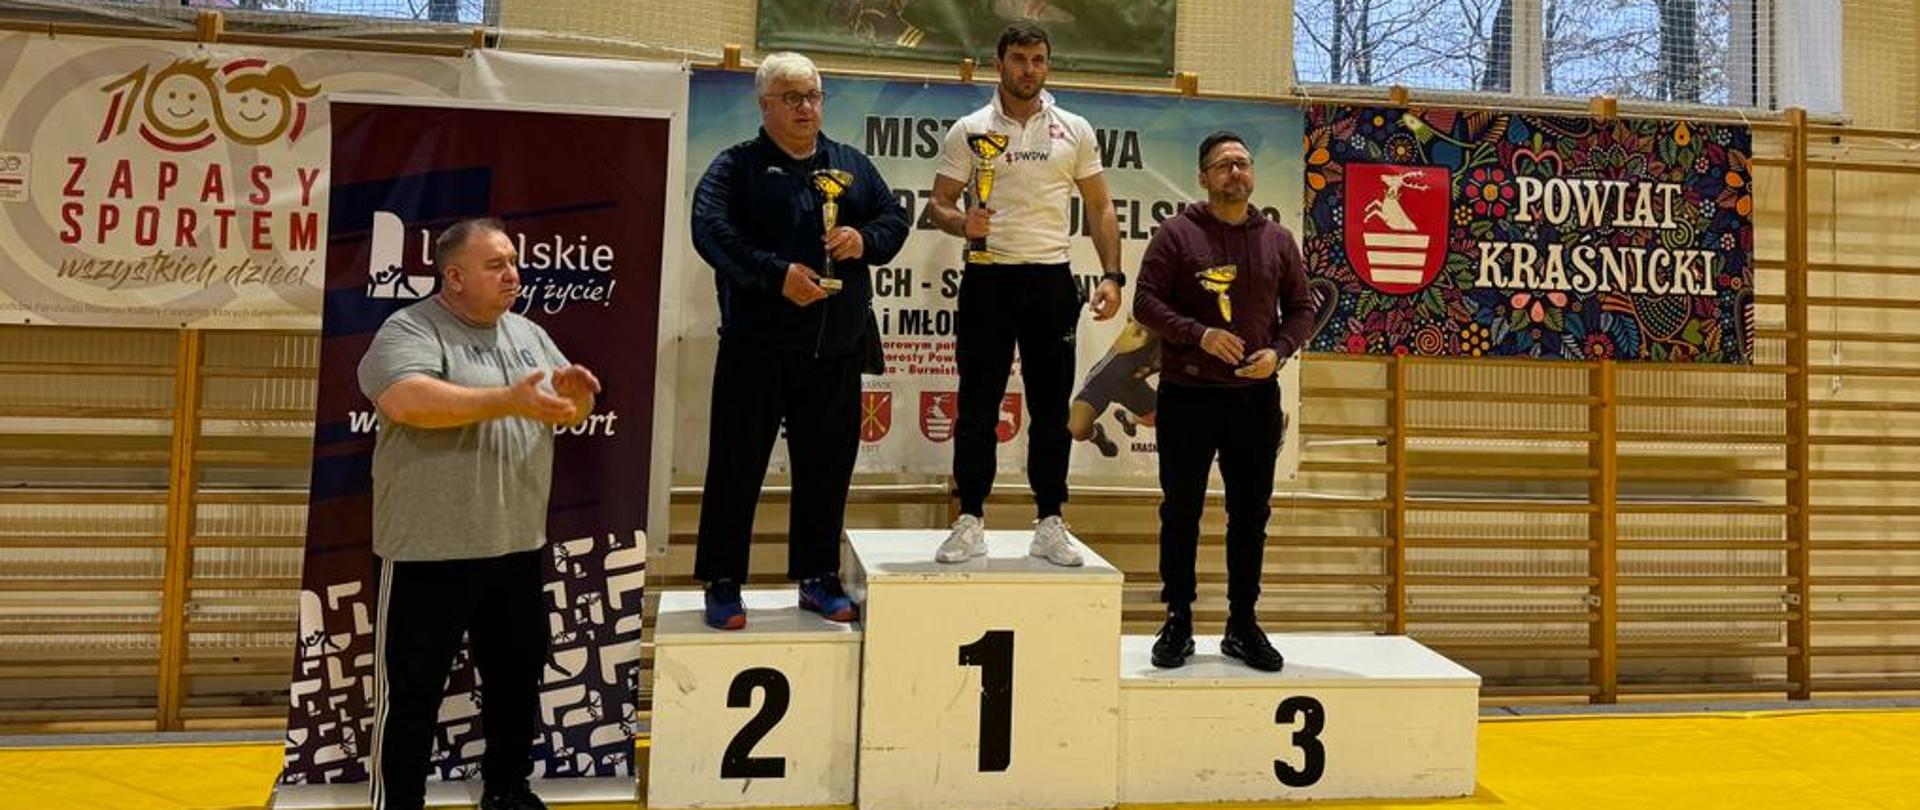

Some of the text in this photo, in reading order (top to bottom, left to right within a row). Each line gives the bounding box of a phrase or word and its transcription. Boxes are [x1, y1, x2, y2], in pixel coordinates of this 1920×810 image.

[62, 157, 320, 206] ZAPASY
[1515, 175, 1682, 229] POWIAT
[60, 202, 318, 250] SPORTEM
[58, 250, 315, 291] wszystkich dzieci
[1475, 235, 1717, 296] KRAŚNICKI
[543, 279, 616, 315] życie!
[720, 666, 790, 779] 2
[958, 630, 1014, 773] 1
[1273, 695, 1326, 788] 3
